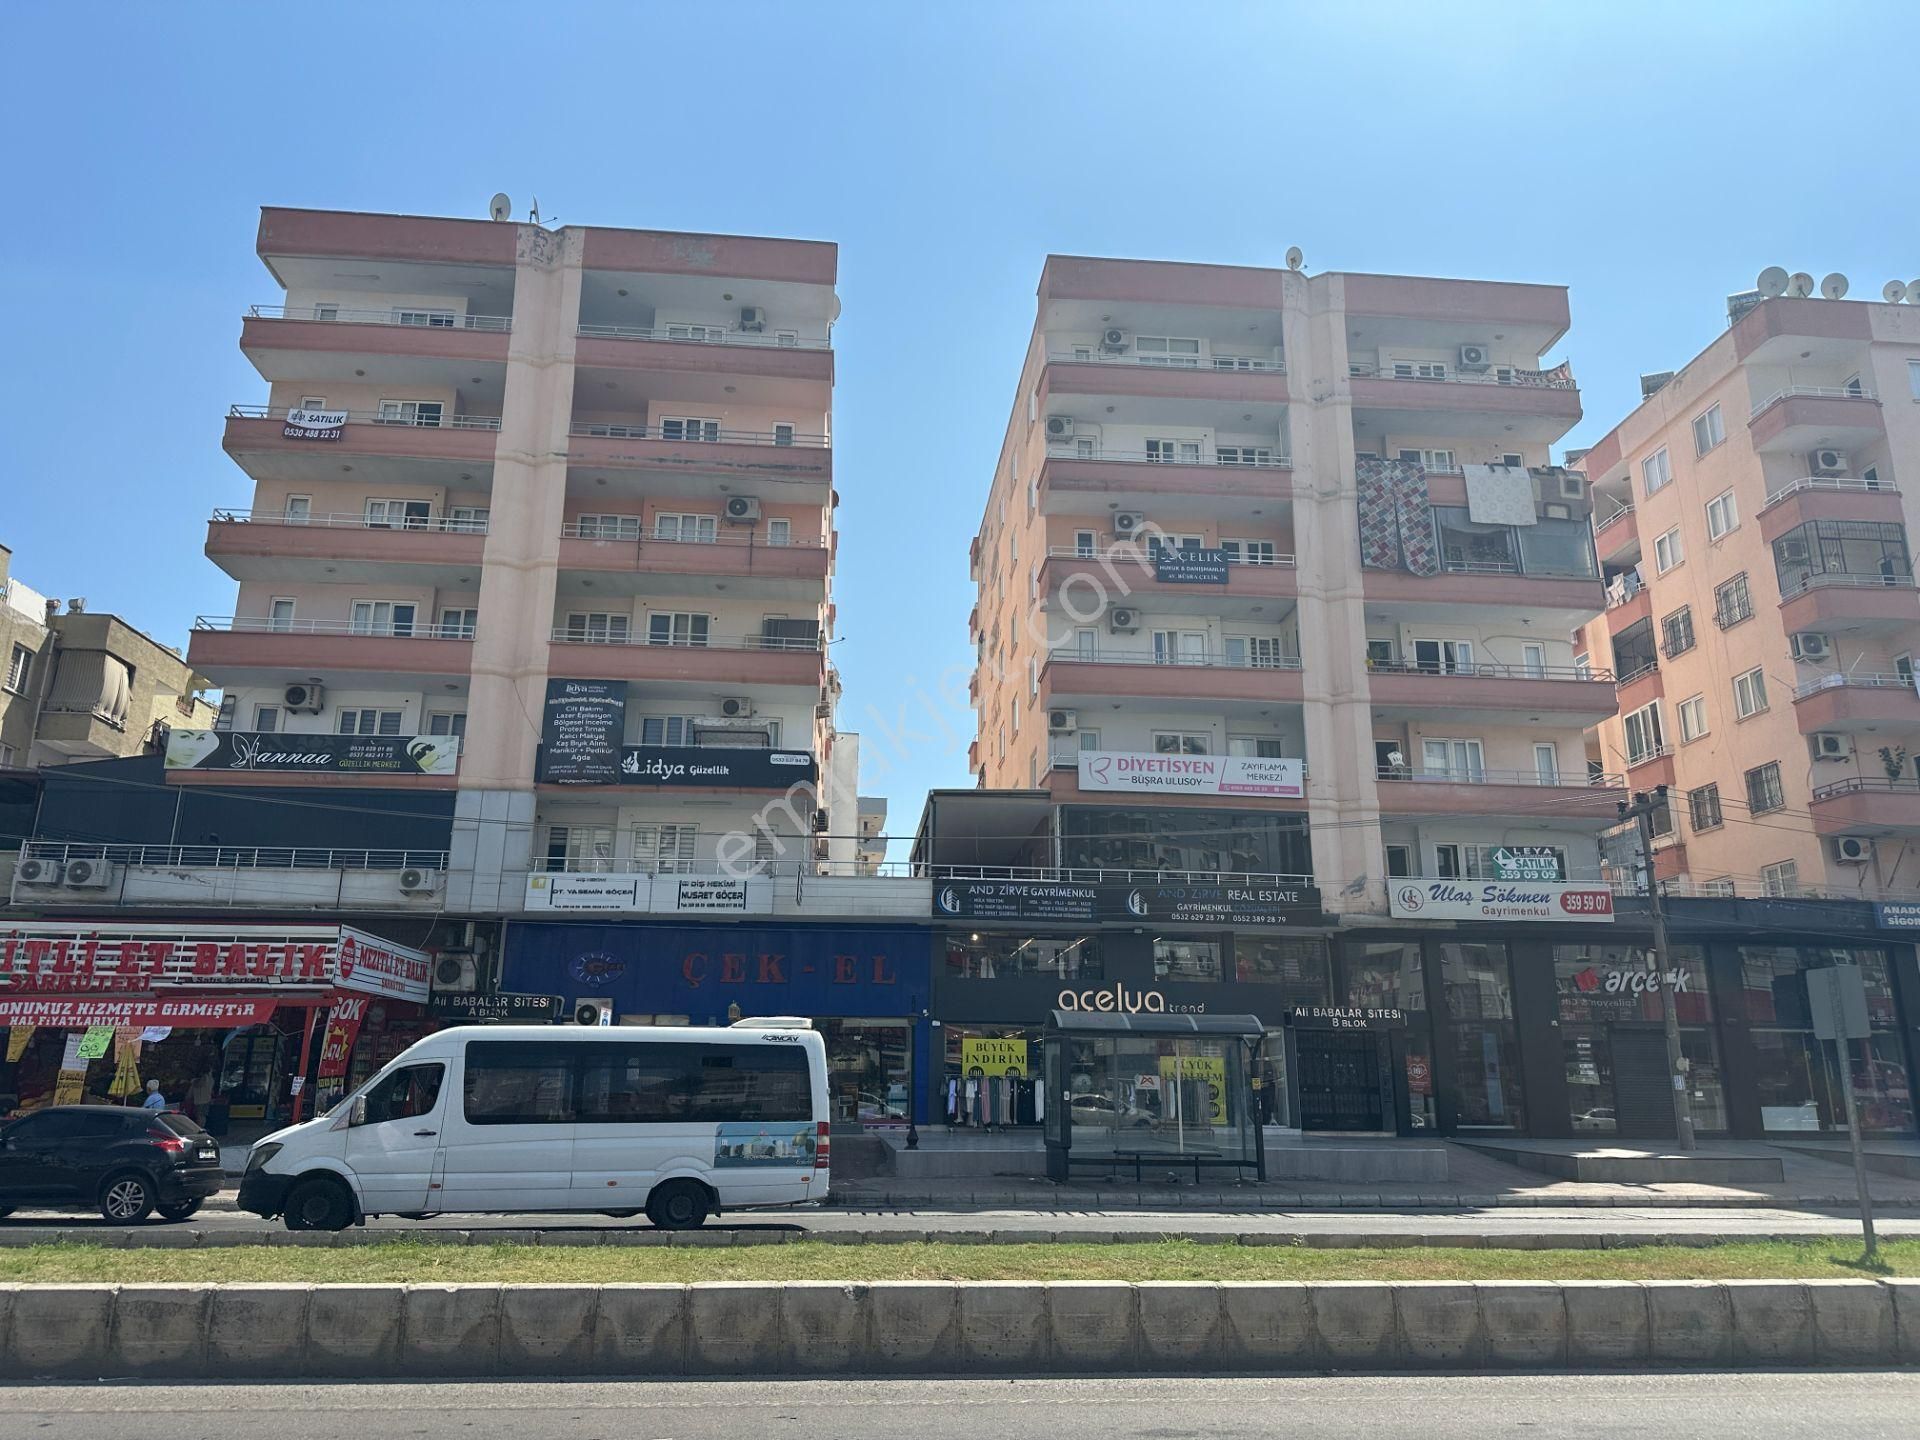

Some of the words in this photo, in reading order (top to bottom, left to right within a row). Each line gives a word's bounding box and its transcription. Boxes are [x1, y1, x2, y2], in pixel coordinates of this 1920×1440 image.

[308, 414, 344, 424] SATILIK
[284, 427, 304, 437] 0530
[305, 428, 319, 438] 488
[320, 430, 330, 438] 22
[577, 712, 612, 720] Epilasyon
[570, 754, 591, 762] Ağda
[630, 751, 684, 780] Lidya
[690, 765, 730, 776] Güzellik
[1117, 756, 1214, 774] DİYETİSYEN
[1241, 762, 1288, 771] ZAYIFLAMA
[1131, 775, 1164, 787] BÜŞRA
[1165, 776, 1203, 786] ULUSOY
[1246, 773, 1283, 782] MERKEZİ
[1514, 858, 1555, 869] SATILIK
[1500, 870, 1521, 879] 359
[1523, 870, 1539, 879] 09
[1541, 870, 1556, 879] 09
[690, 879, 706, 888] DİŞ
[706, 879, 736, 888] HEKİMİ
[605, 888, 633, 896] GÖÇER
[681, 891, 714, 900] NUSRET
[715, 890, 744, 901] GÖÇER
[968, 885, 994, 895] AND
[999, 884, 1028, 896] ZİRVE
[1030, 886, 1097, 899] GAYRİMENKUL
[1227, 889, 1256, 901] REAL
[1258, 890, 1299, 902] ESTATE
[1428, 883, 1473, 905] Ulaş
[1481, 885, 1551, 904] Sökmen
[1177, 902, 1233, 913] GAYRİMENKUL
[1566, 895, 1582, 910] 359
[1583, 896, 1595, 910] 59
[1595, 896, 1606, 911] 07
[1481, 905, 1550, 917] Gayrimenkul
[1171, 913, 1189, 921] 0532
[116, 943, 175, 974] ET
[191, 943, 328, 977] BALIK
[682, 952, 788, 988] ÇEK
[833, 955, 896, 985] EL
[1605, 968, 1690, 998] arçek
[468, 1007, 477, 1017] A
[1169, 1003, 1205, 1013] trend
[1313, 1007, 1362, 1018] BABALAR
[9, 1016, 35, 1026] HAL
[1332, 1018, 1340, 1027] B
[1341, 1019, 1367, 1028] BLOK
[976, 1041, 1015, 1052] BÜYÜK
[965, 1052, 1025, 1064] İNDİRİM
